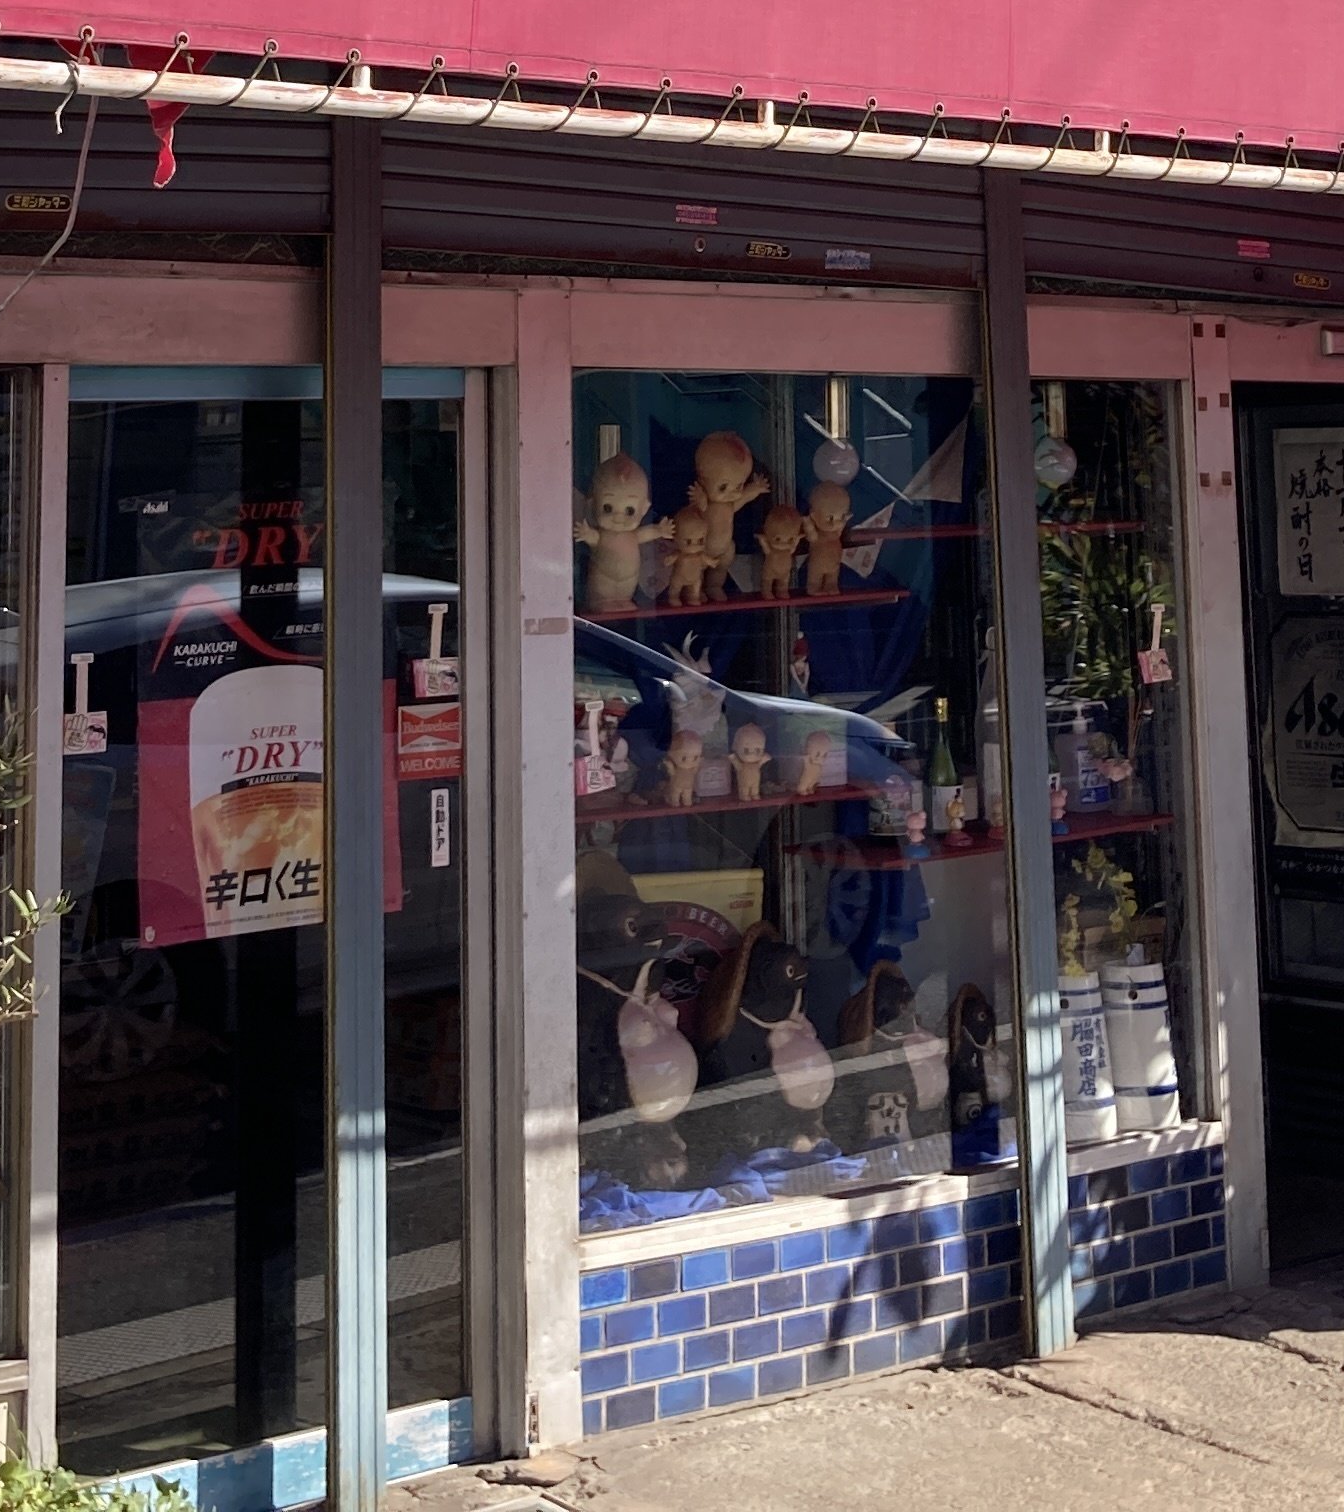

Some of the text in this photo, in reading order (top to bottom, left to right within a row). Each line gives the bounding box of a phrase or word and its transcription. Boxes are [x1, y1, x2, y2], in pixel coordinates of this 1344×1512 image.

[238, 501, 305, 520] SUPER
[174, 641, 237, 657] KARAKUCHI
[249, 725, 297, 741] SUPER
[400, 756, 461, 772] WELCOME
[434, 794, 446, 852] 自動ドア
[687, 906, 730, 938] BEER
